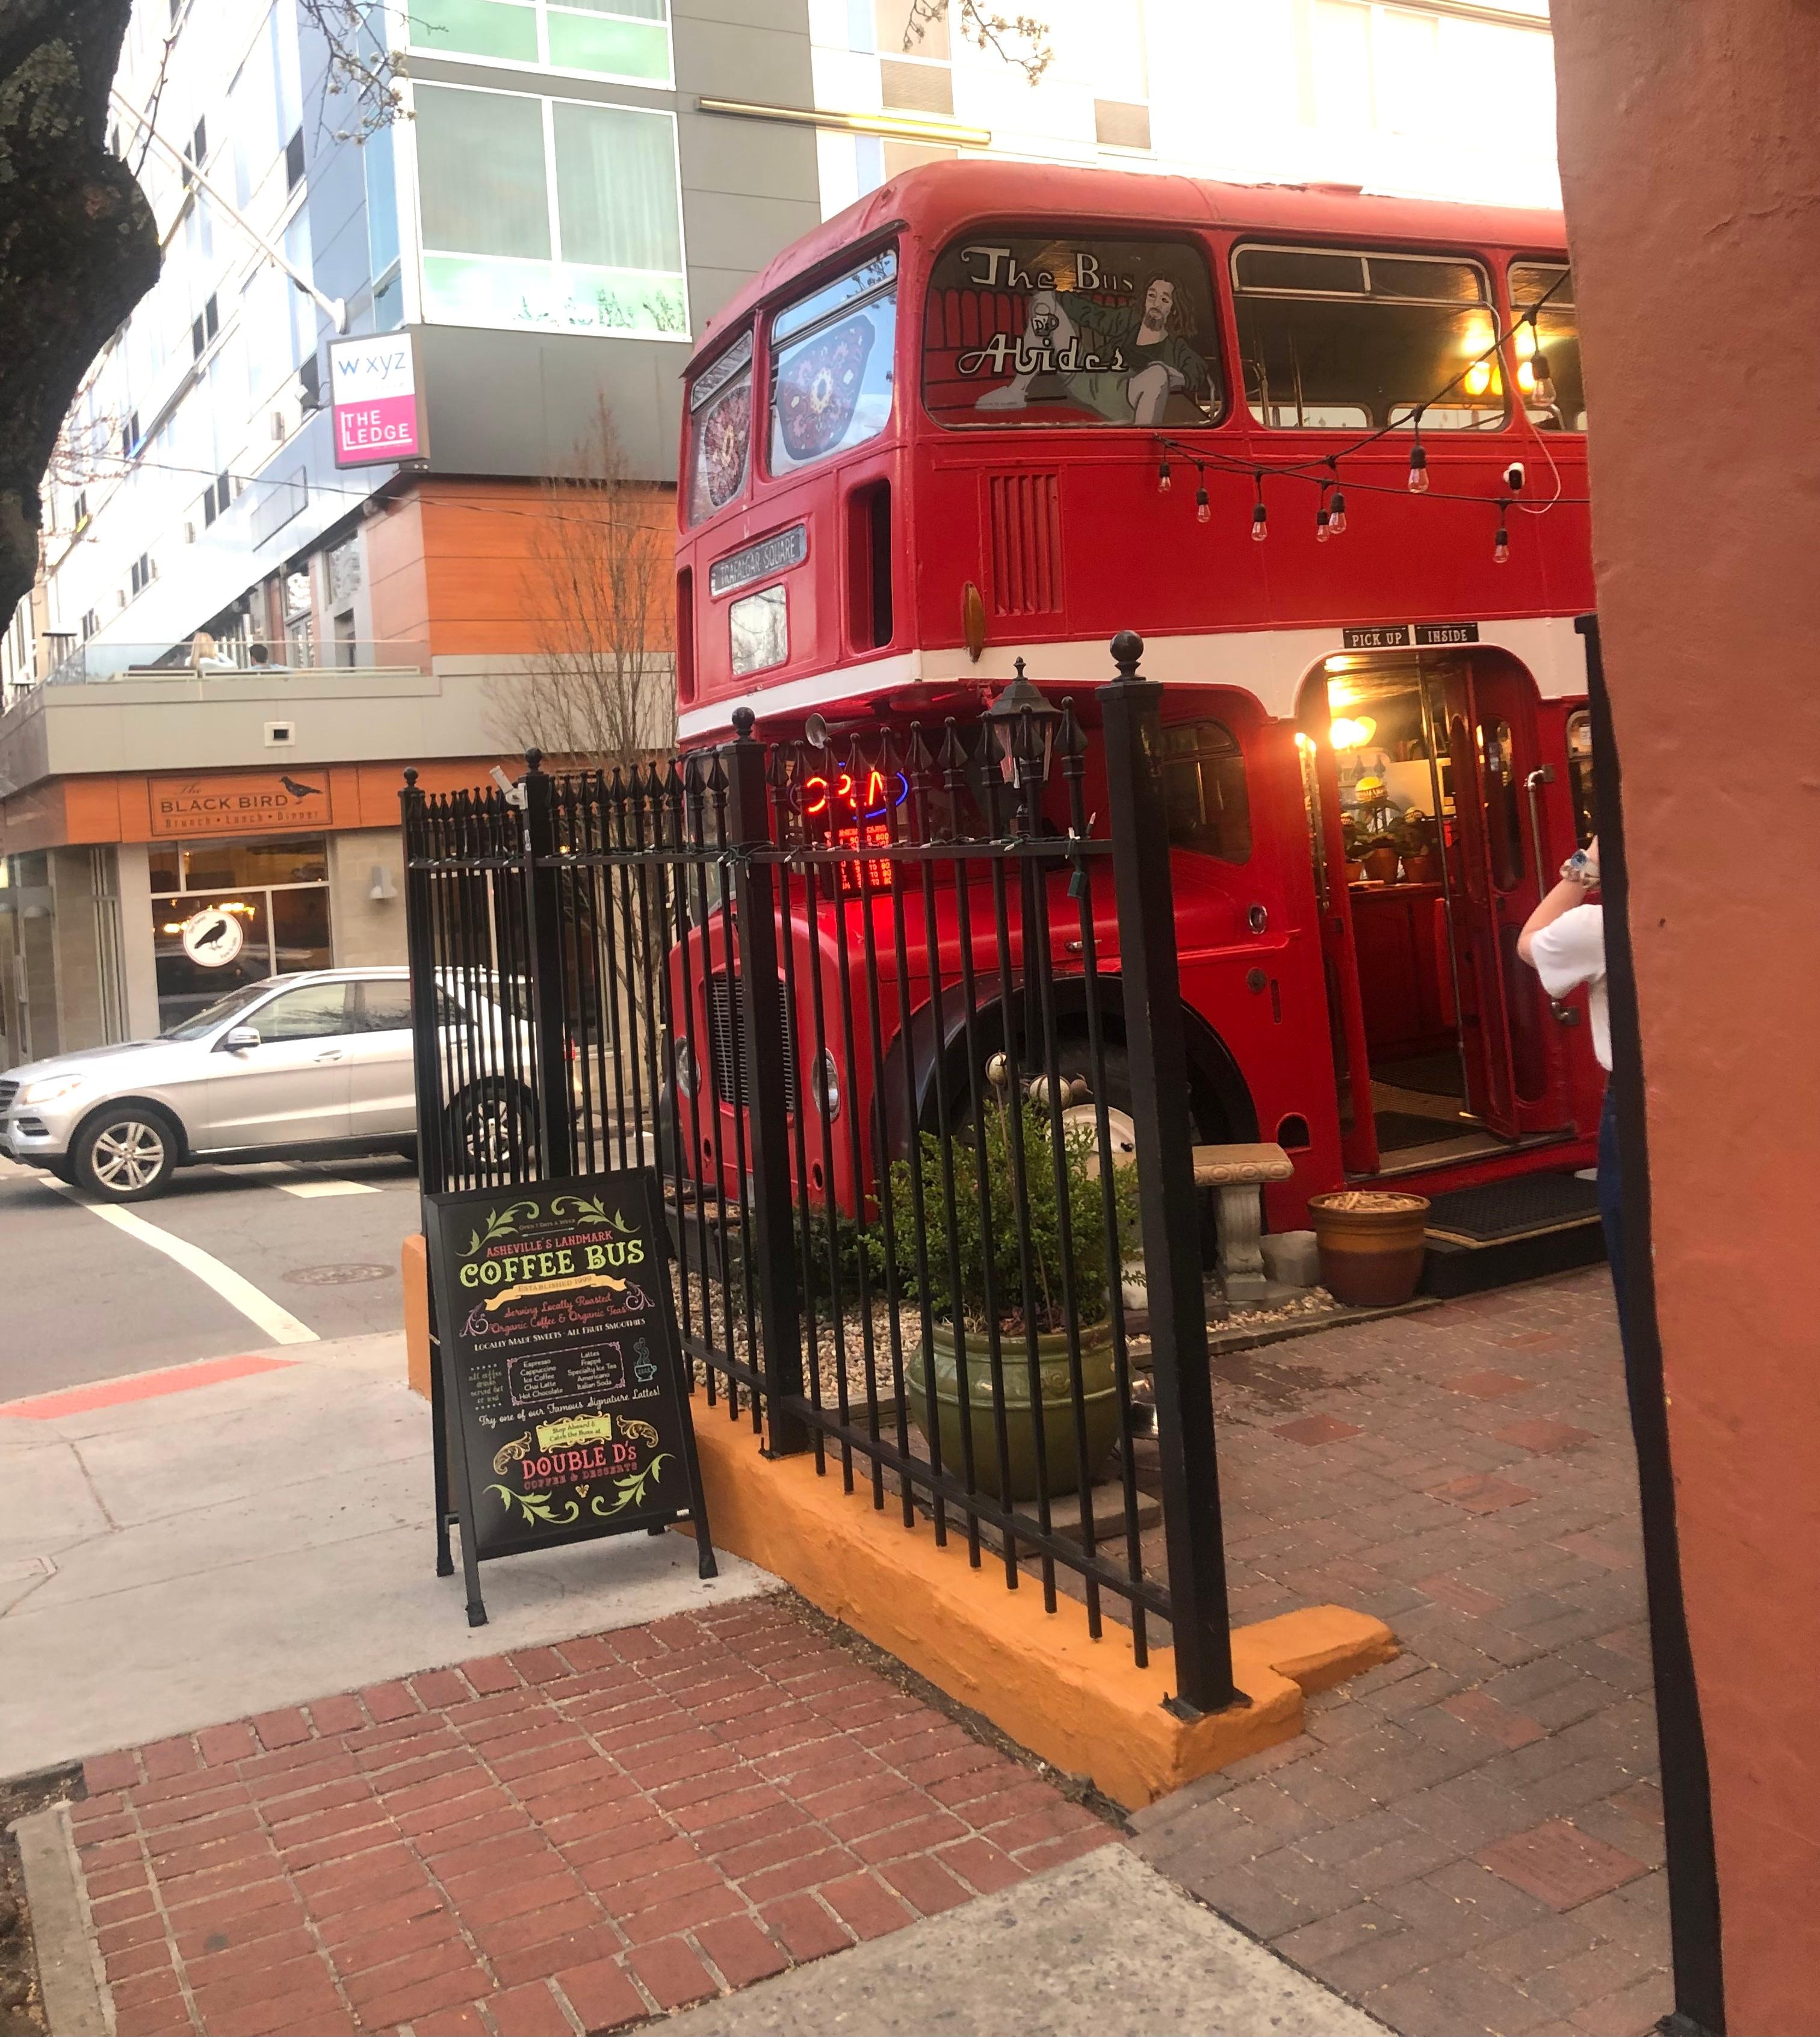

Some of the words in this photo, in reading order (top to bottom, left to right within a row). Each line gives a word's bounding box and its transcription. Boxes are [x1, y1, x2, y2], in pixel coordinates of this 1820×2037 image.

[961, 246, 1054, 289] The
[1076, 252, 1133, 289] Bus
[958, 333, 1129, 374] Abides
[344, 410, 381, 428] THE
[346, 423, 410, 445] LEDGE
[720, 552, 761, 586] TRAFALGAR
[764, 535, 795, 569] SQUARE
[1352, 632, 1381, 646] PICK
[1386, 632, 1402, 645] UP
[1428, 629, 1468, 643] INSIDE
[161, 798, 231, 813] BLACK
[239, 794, 288, 809] BIRD
[166, 815, 211, 828] Brunch
[226, 813, 263, 824] Lunch
[277, 810, 318, 821] Dinner
[486, 1237, 552, 1258] ASHEVILLE'S
[555, 1230, 613, 1247] LANDMARK
[460, 1249, 575, 1288] COFFEE
[584, 1239, 645, 1270] BUS
[518, 1280, 572, 1292] ESTABLISHED
[575, 1276, 592, 1284] 1999
[504, 1306, 538, 1320] Serving
[541, 1299, 574, 1313] Locally
[575, 1292, 612, 1306] Roasted
[491, 1321, 528, 1336] Organic
[530, 1315, 557, 1329] Coffee
[559, 1313, 566, 1323] &
[568, 1309, 605, 1324] Organic
[607, 1305, 626, 1316] Teas
[474, 1340, 506, 1352] LOCALLY
[508, 1336, 532, 1346] MADE
[533, 1331, 562, 1342] SWEETS
[567, 1328, 581, 1337] ALL
[582, 1325, 603, 1334] FRUIT
[604, 1318, 646, 1331] SMOOTHIES
[523, 1359, 551, 1368] Espresso
[580, 1350, 600, 1359] Lattes
[519, 1365, 557, 1376] Cappuccino
[533, 1373, 555, 1382] Coffee
[567, 1366, 596, 1377] Specialty
[577, 1372, 610, 1382] Americano
[532, 1388, 563, 1397] Chocolate
[577, 1382, 596, 1391] Italian
[596, 1379, 612, 1387] Soda
[478, 1414, 497, 1429] Try
[499, 1414, 515, 1423] one
[517, 1408, 527, 1421] of
[528, 1408, 545, 1418] our
[546, 1402, 584, 1414] Famous
[587, 1394, 630, 1410] Signature
[632, 1385, 660, 1400] Lattes!
[521, 1447, 607, 1480] DOUBLE
[524, 1474, 567, 1491] COFFEE
[582, 1462, 638, 1479] DESSERTS
